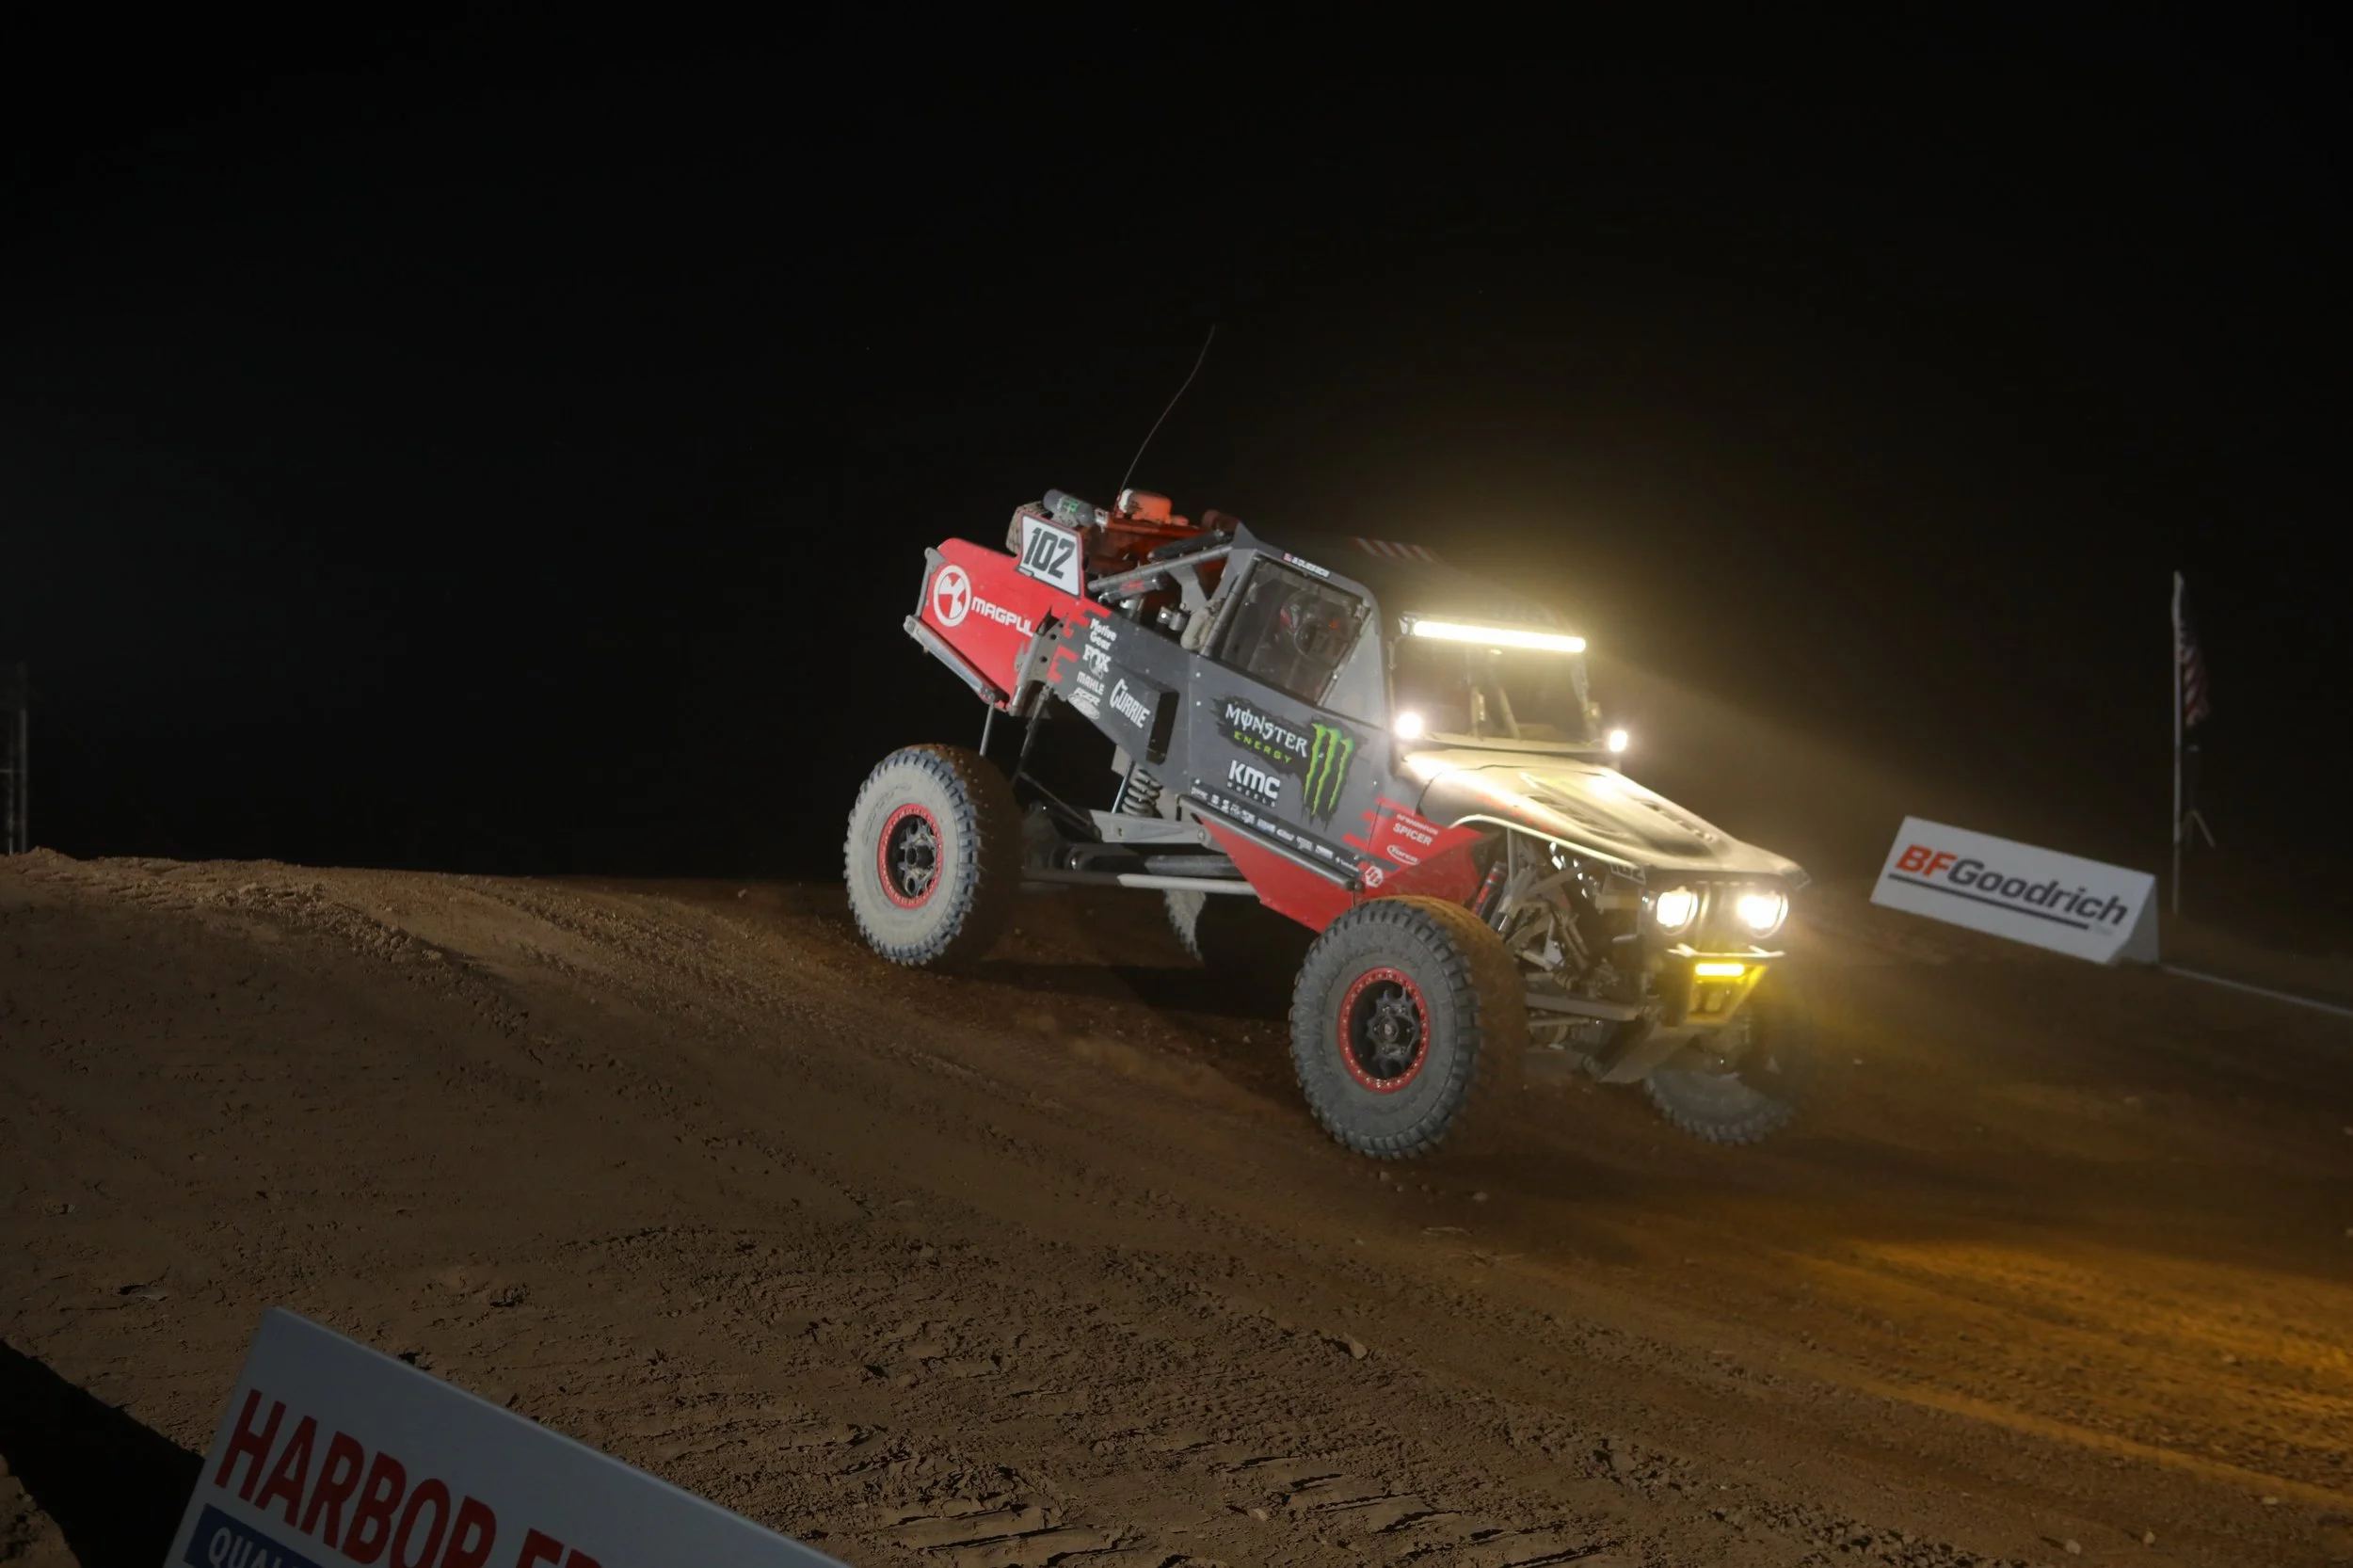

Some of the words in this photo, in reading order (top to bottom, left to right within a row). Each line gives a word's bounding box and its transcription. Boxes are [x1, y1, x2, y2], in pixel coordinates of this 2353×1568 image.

[1023, 527, 1075, 580] 102
[971, 596, 1035, 638] MAGPUL
[1082, 643, 1112, 677] FOX
[1077, 670, 1105, 696] MAHLE
[1110, 678, 1150, 728] CURRIE
[1225, 703, 1307, 758] MONSTER
[1234, 730, 1291, 763] ENERGY
[1228, 760, 1280, 799] KMC
[1393, 823, 1433, 846] SPICER
[1895, 844, 2128, 925] BFGoodrich
[214, 1389, 498, 1568] HARBOR
